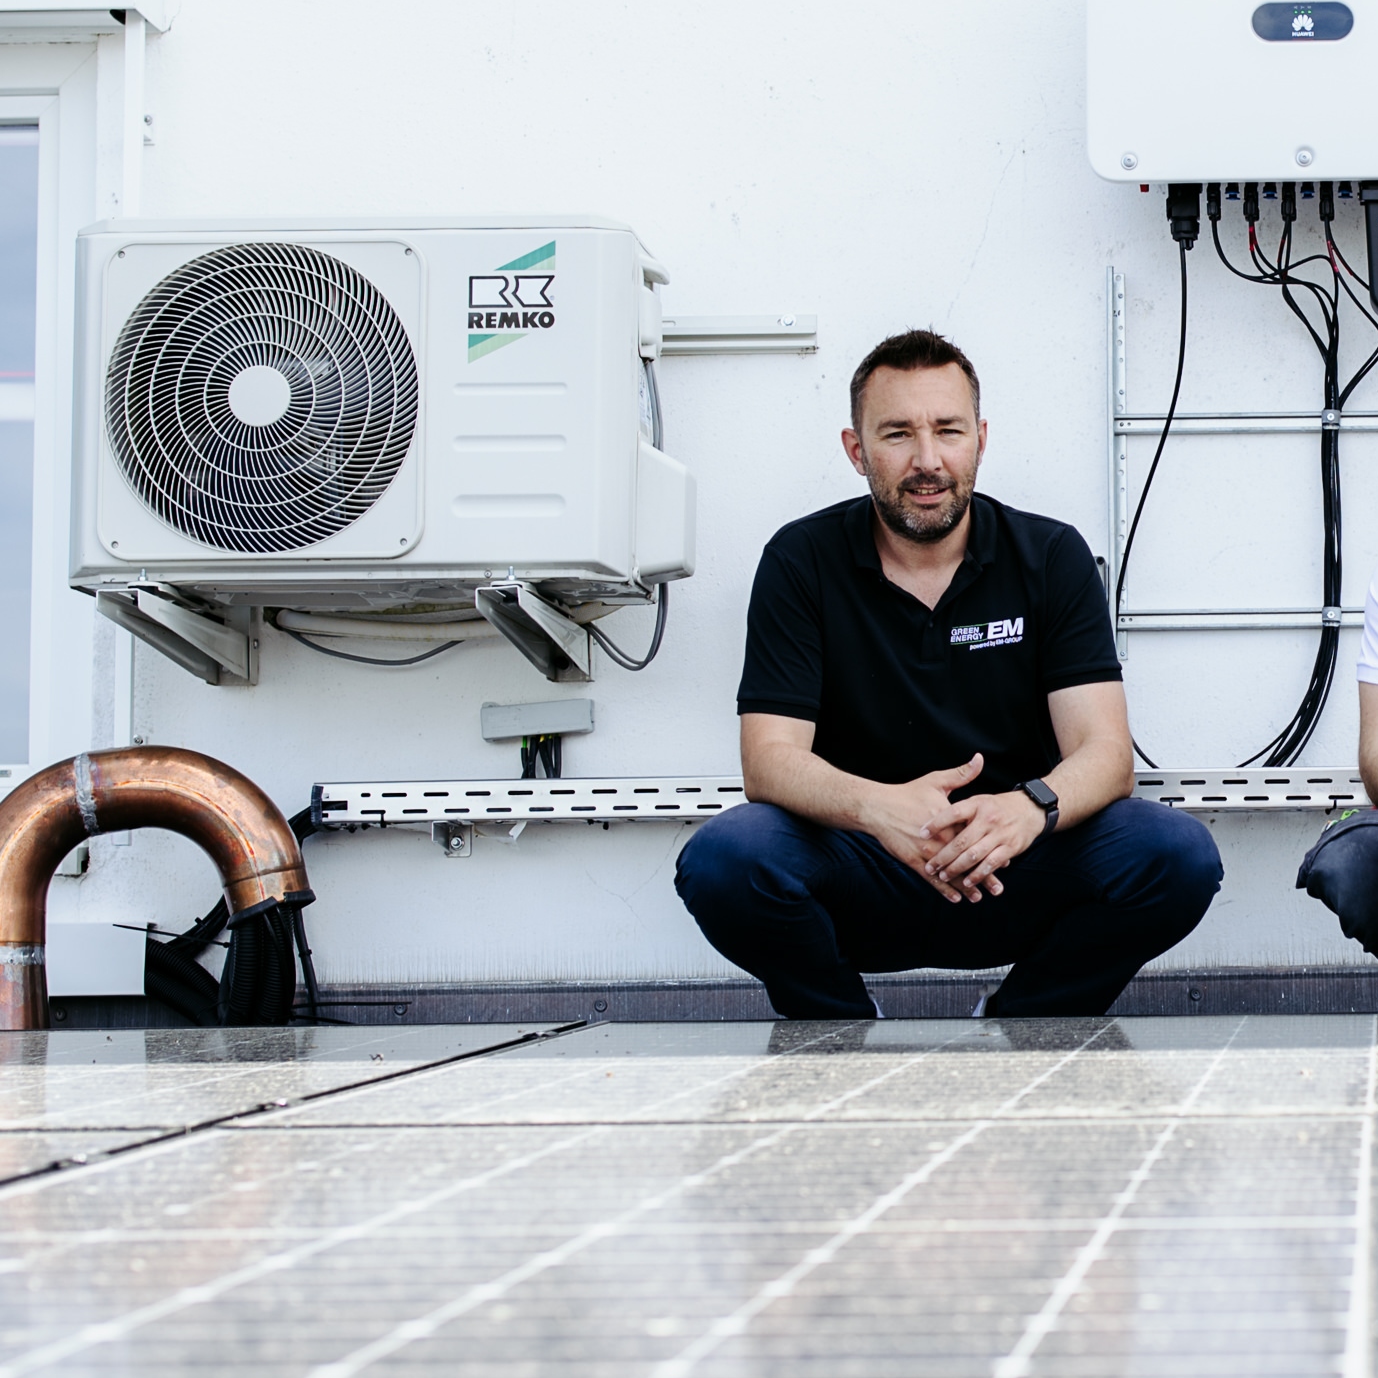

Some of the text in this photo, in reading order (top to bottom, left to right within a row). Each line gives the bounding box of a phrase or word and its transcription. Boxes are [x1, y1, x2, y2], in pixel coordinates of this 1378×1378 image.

[467, 311, 555, 329] REMKO
[950, 626, 980, 636] GREEN
[987, 617, 1024, 640] EM
[950, 632, 984, 643] ENERGY
